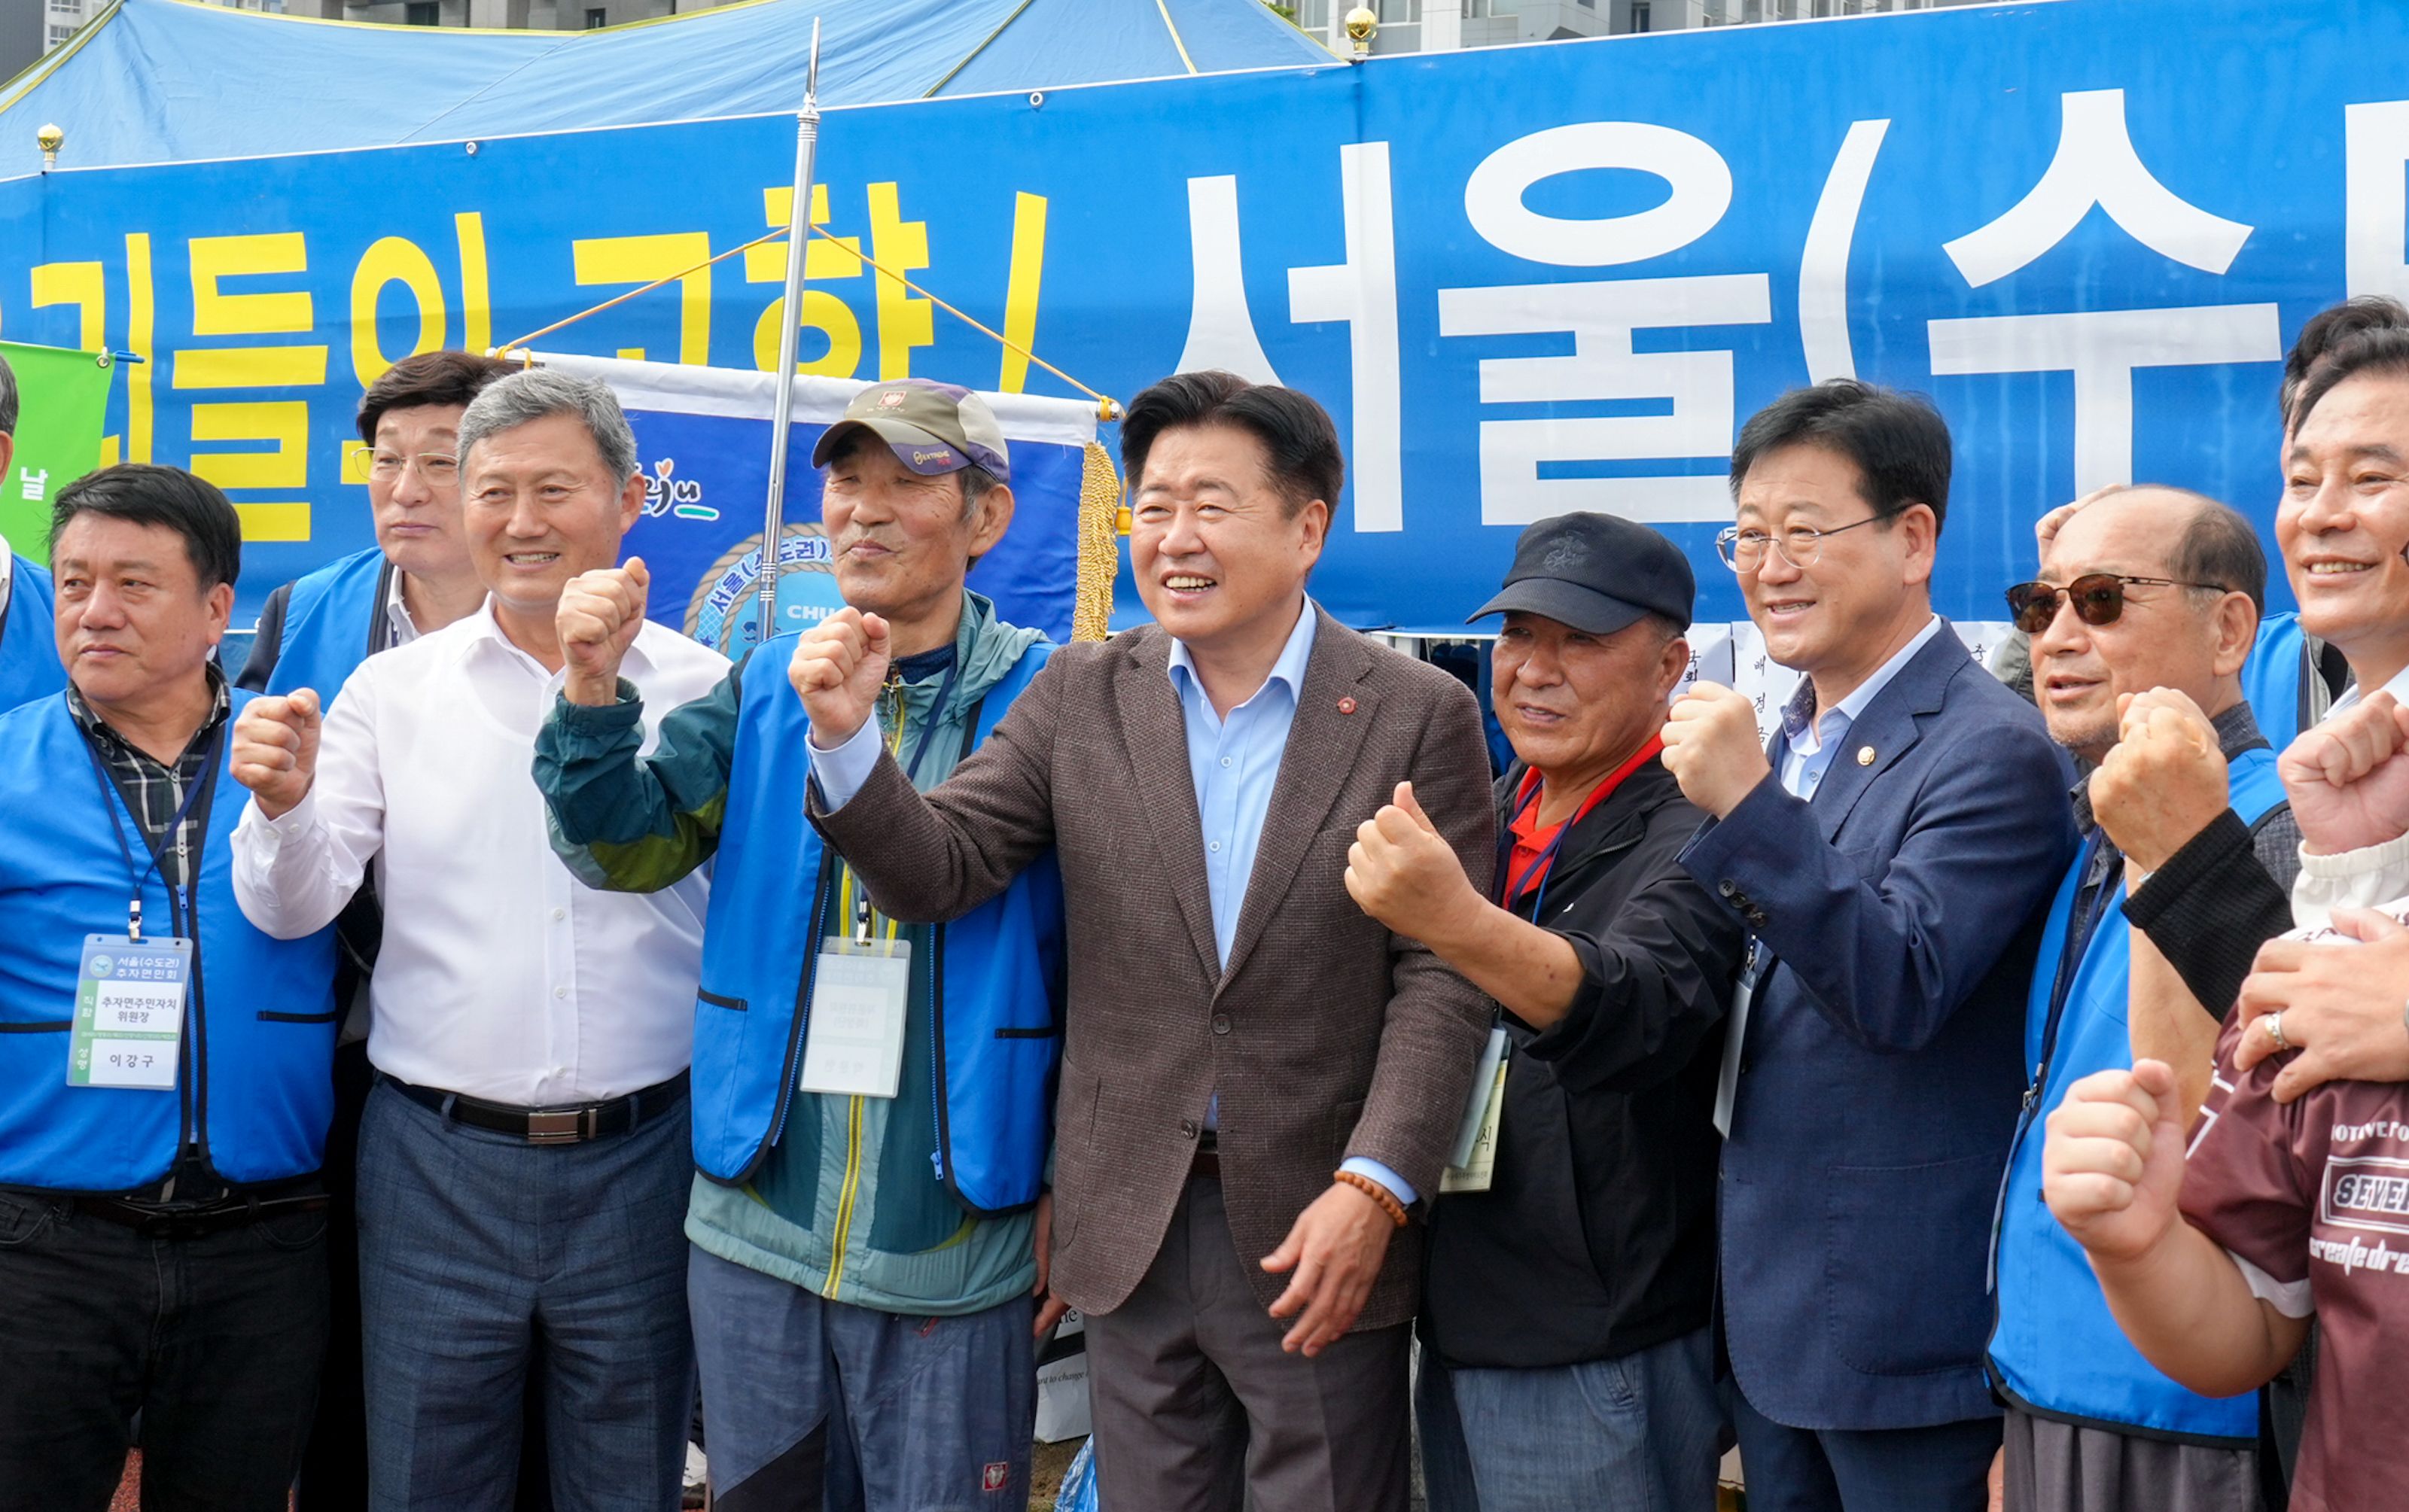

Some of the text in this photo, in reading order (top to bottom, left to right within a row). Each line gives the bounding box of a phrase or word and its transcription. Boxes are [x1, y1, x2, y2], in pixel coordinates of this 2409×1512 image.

[20, 467, 48, 500] 날
[634, 458, 702, 518] eju
[117, 956, 180, 969] 서울(수도권)
[101, 996, 177, 1010] 추자면주민자치
[117, 1011, 149, 1024] 위원장
[109, 1054, 154, 1069] 이강구
